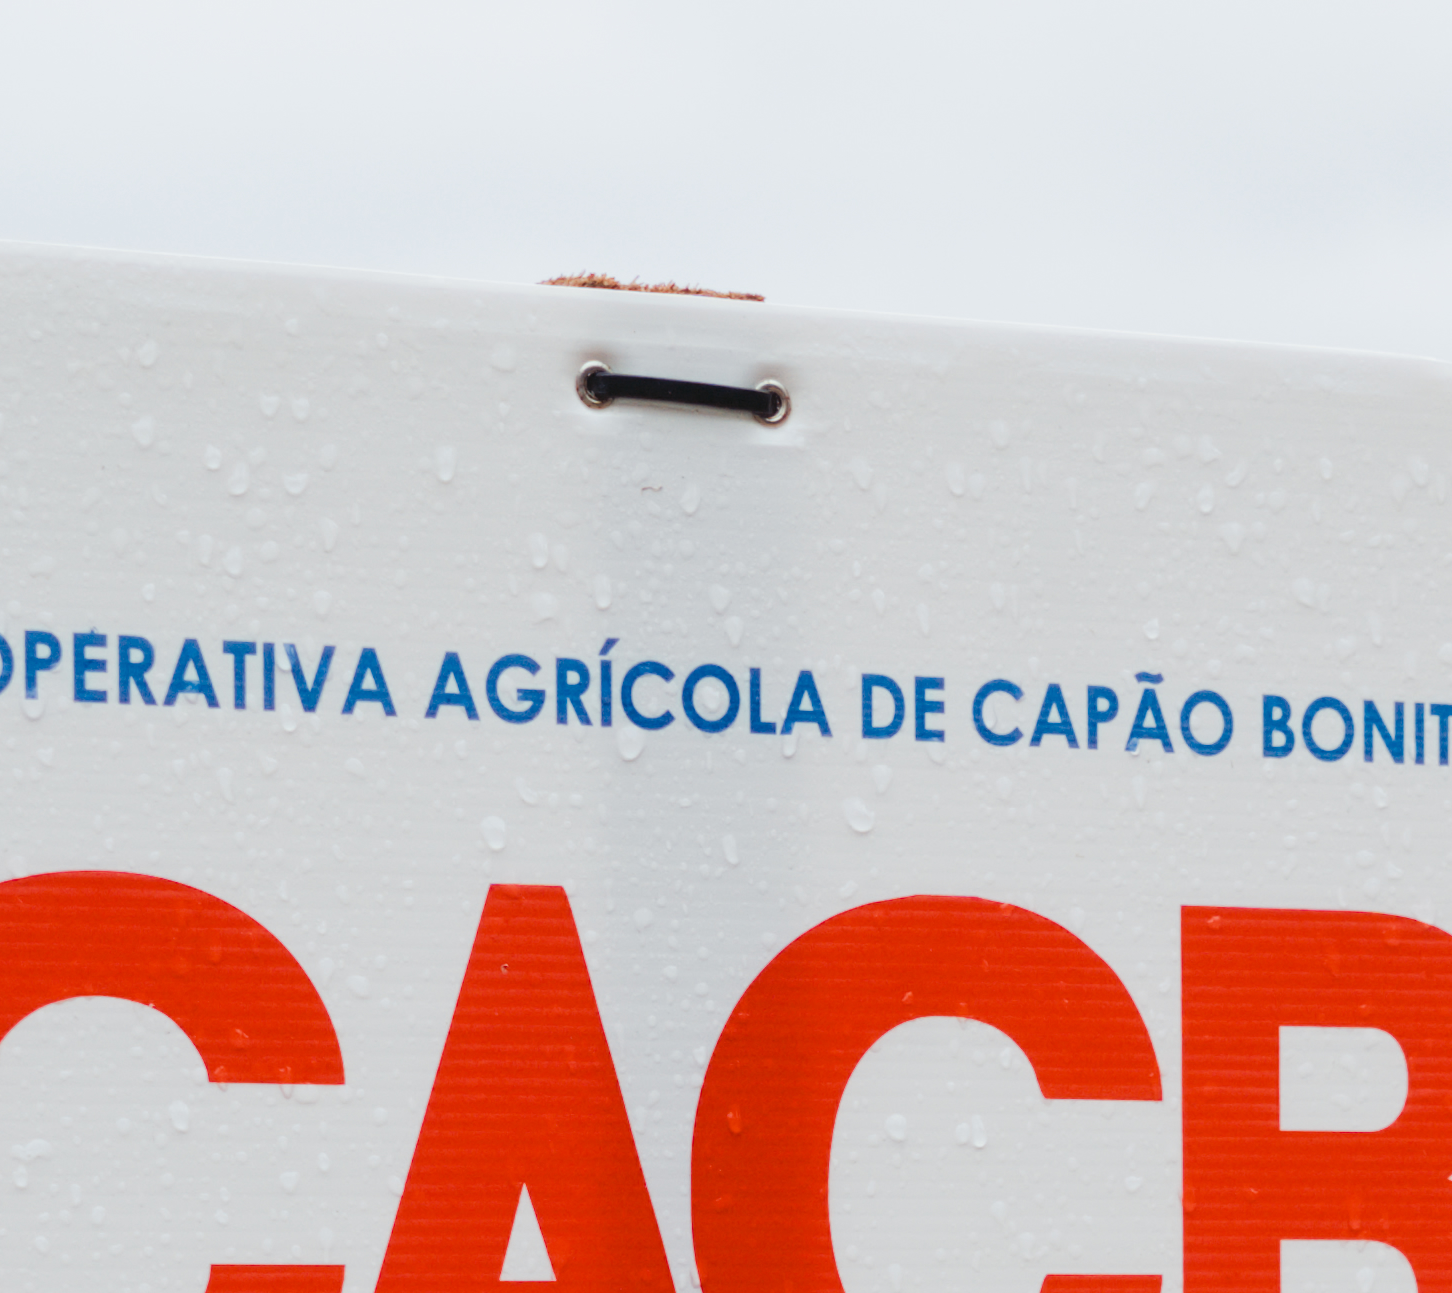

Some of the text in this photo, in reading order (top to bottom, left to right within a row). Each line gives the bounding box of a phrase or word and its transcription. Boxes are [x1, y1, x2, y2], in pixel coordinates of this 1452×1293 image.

[425, 637, 832, 737] AGRÍCOLA
[861, 673, 945, 743] DE
[971, 671, 1234, 757] CAPÃO
